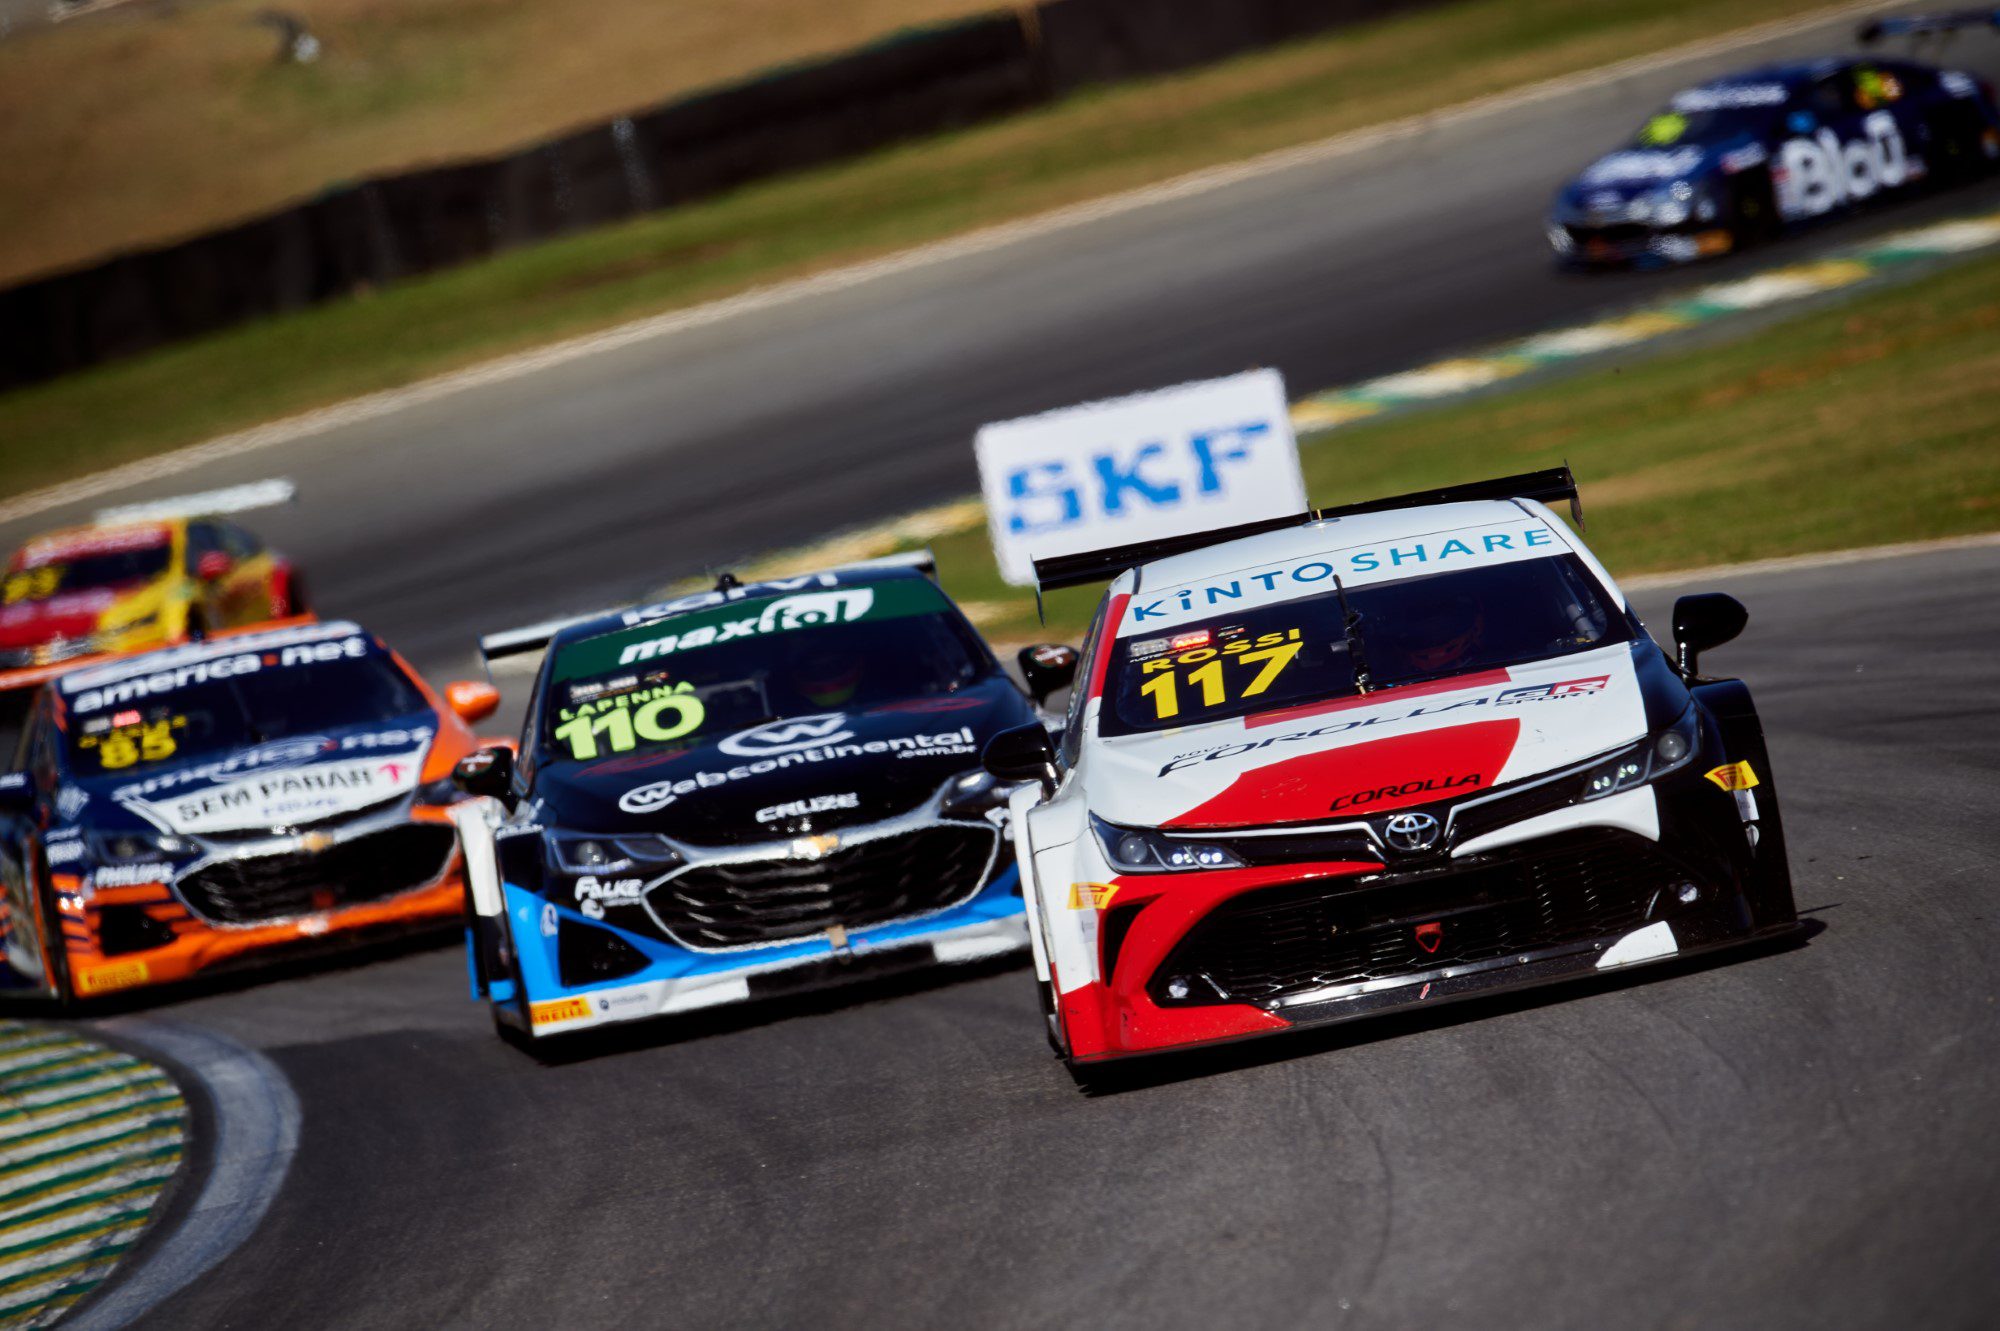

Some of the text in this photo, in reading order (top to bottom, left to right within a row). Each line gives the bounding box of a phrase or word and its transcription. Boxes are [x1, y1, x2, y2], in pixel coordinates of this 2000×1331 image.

[1007, 420, 1269, 534] SKF
[1350, 528, 1553, 573] SHARE
[1142, 627, 1302, 675] ROSSI
[559, 681, 696, 722] LAPENNA
[1140, 641, 1304, 720] 117
[99, 724, 177, 769] 85
[555, 694, 705, 761] 110
[1157, 696, 1492, 778] COROLLA
[1173, 744, 1231, 760] NOVO
[177, 788, 250, 823] SEM
[755, 792, 860, 824] CRUZE
[1328, 773, 1482, 812] COROLLA
